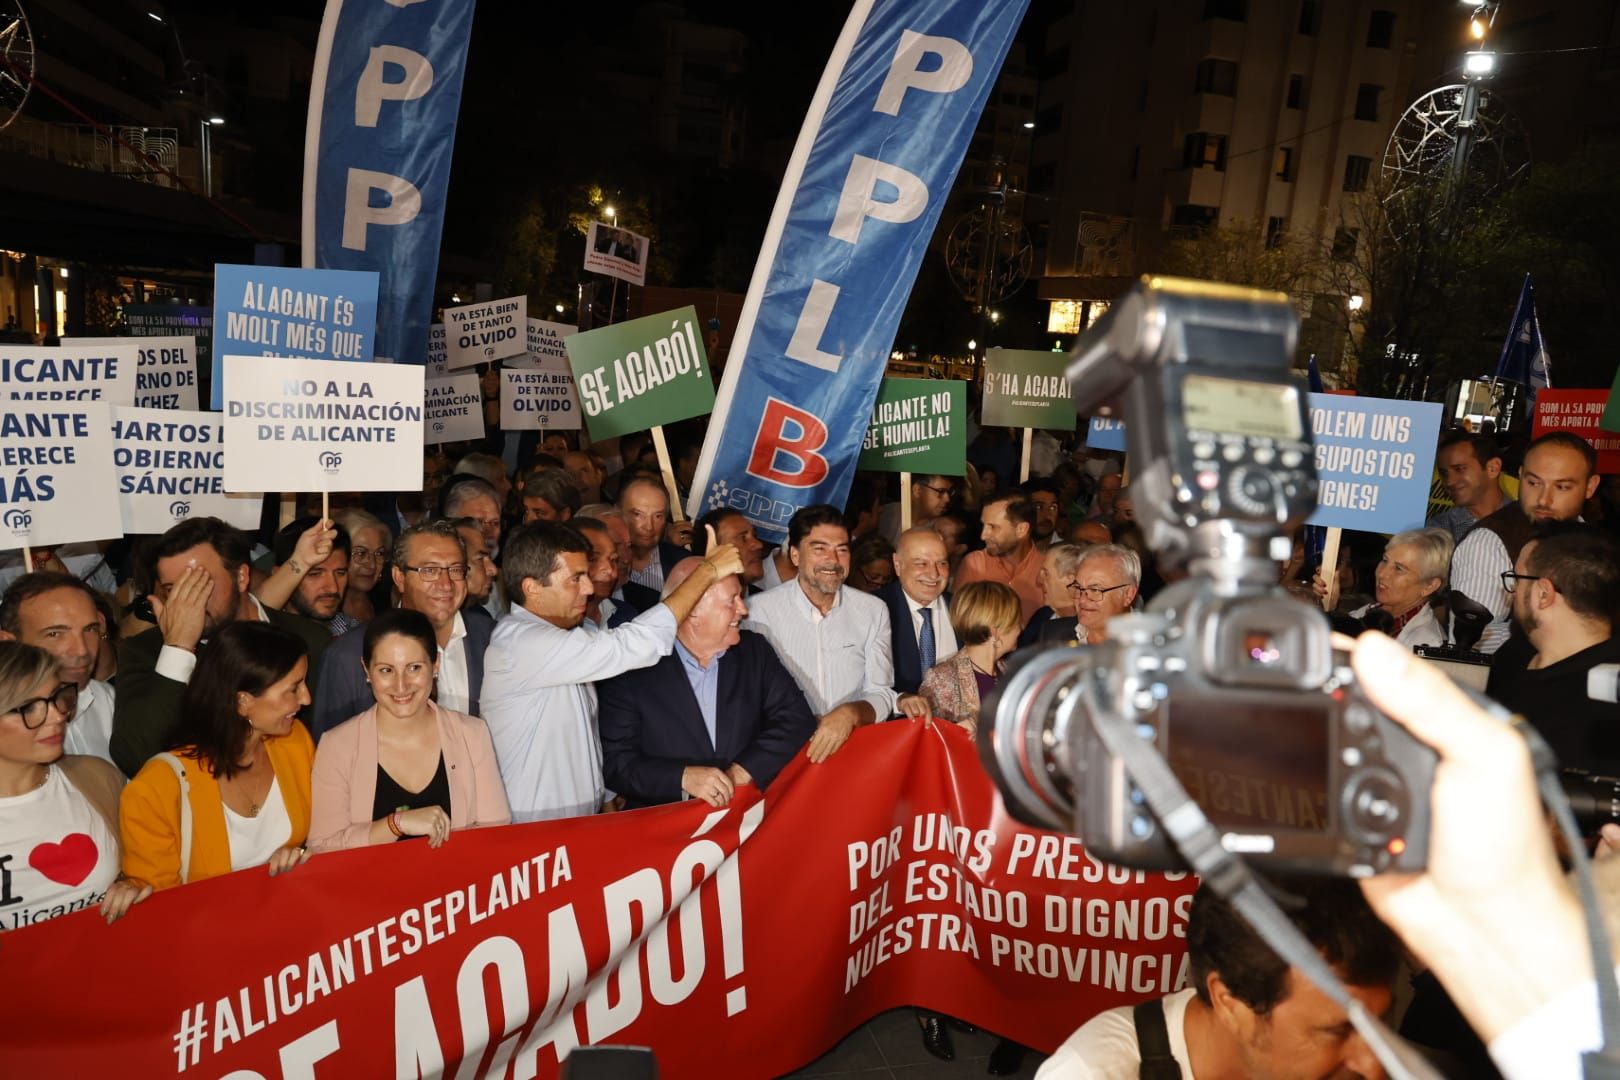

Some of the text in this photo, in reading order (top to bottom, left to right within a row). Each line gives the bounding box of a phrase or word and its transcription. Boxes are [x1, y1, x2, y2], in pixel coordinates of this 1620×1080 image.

[242, 281, 354, 327] ALACANT ÉS
[451, 302, 519, 322] YA ESTÁ BIEN
[462, 315, 513, 332] DE TANTO
[537, 327, 544, 335] A
[545, 329, 557, 338] LA
[227, 311, 364, 359] MOLT MÉS QUE
[459, 326, 517, 349] OLVIDO
[161, 348, 188, 365] DEL
[580, 319, 703, 416] SE ACABÓ!
[176, 370, 194, 387] DE
[282, 380, 374, 398] NO A LA
[508, 373, 574, 385] YA ESTÁ BIEN
[985, 372, 1019, 396] S'HA
[432, 386, 455, 396] A LA
[518, 387, 568, 395] DE TANTO
[228, 400, 421, 422] DISCRIMINACIÓN
[513, 399, 571, 412] OLVIDO
[868, 391, 951, 426] LICANTE NO
[1540, 402, 1559, 414] SOM
[1560, 402, 1570, 414] LA
[1572, 402, 1583, 414] 5A
[111, 420, 211, 443] HARTOS
[1371, 414, 1412, 443] UNS
[1541, 414, 1600, 428] MÉS APORTA A
[258, 425, 396, 442] DE ALICANTE
[863, 415, 950, 450] SE HUMILLA!
[0, 446, 76, 466] ERECE
[120, 471, 226, 495] SÁNCHE
[728, 487, 807, 522] SPP
[848, 825, 903, 891] POR
[912, 813, 997, 873] UNOS
[849, 859, 1193, 945] DEL ESTADO DIGNOS
[173, 845, 573, 1073] #ALICANTESEPLANTA
[844, 913, 1190, 995] NUESTRA PROVINCIA
